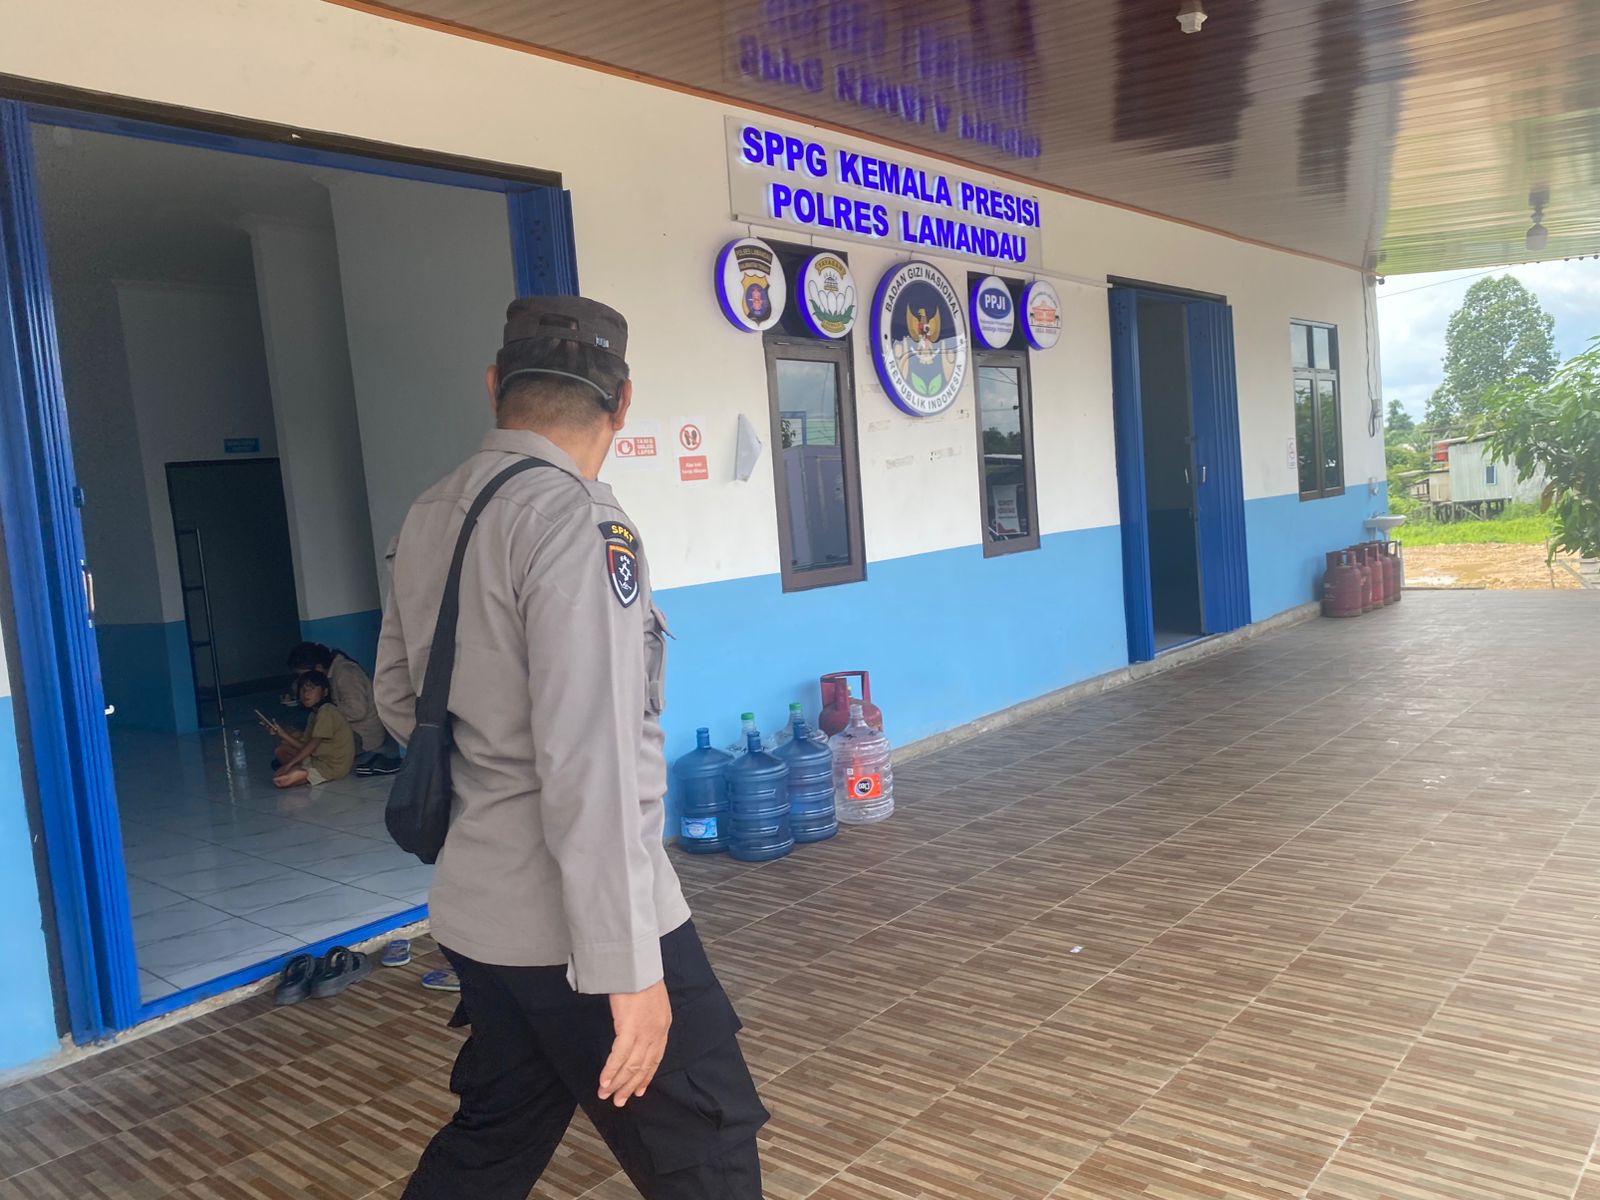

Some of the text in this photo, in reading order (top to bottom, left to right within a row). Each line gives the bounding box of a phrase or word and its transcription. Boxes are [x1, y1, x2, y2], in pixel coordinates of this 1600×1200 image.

[742, 126, 1040, 228] SPPG KEMALA PRESISI
[773, 183, 1027, 263] POLRES LAMANDAU
[885, 267, 959, 320] BADAN GIZI NASIONAL
[984, 294, 1006, 311] PPJI
[888, 359, 962, 411] REPUBLIK INDONESIA
[611, 524, 634, 543] SPKT
